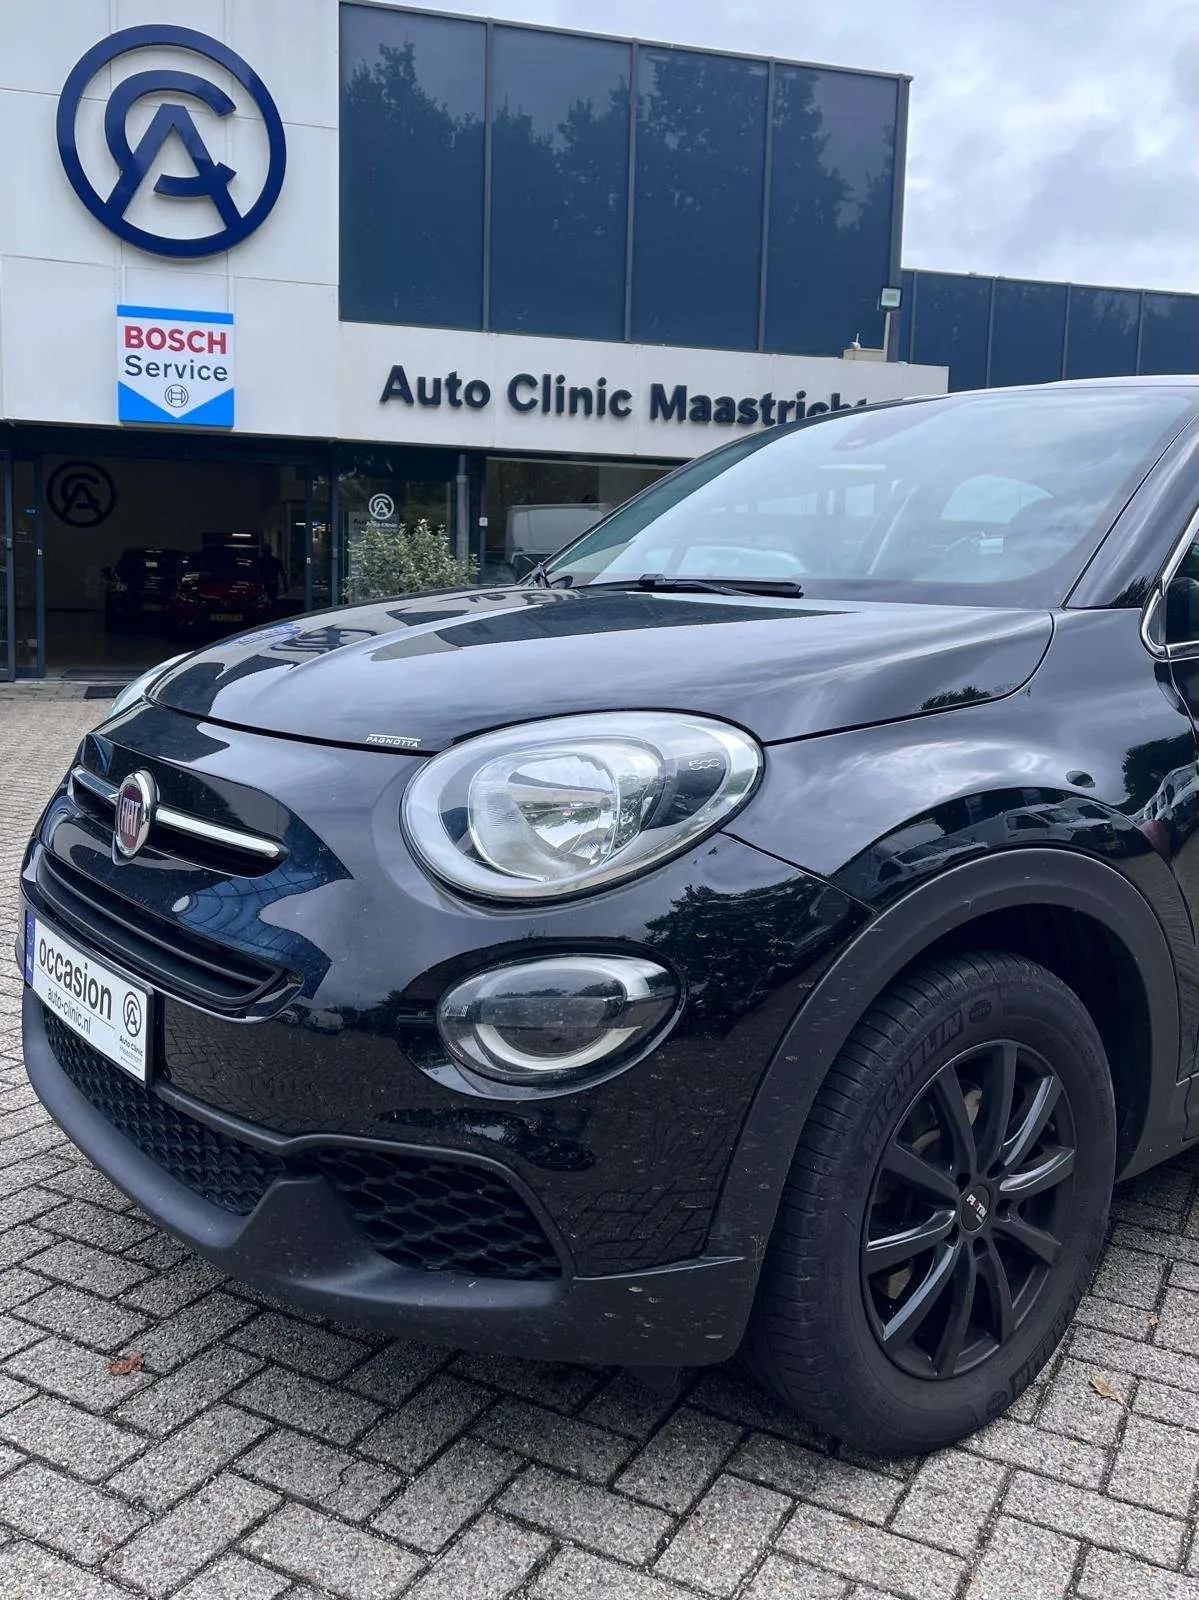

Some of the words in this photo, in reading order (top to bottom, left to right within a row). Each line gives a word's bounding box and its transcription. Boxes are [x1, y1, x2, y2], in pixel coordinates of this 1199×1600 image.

[124, 325, 228, 355] BOSCH
[124, 354, 228, 382] Service
[379, 364, 491, 409] Auto
[506, 373, 633, 418] Clinic
[649, 382, 867, 427] Maastri
[366, 736, 418, 748] PAGNOTTA
[689, 758, 720, 770] 500
[119, 796, 142, 838] FIAT
[39, 938, 112, 1020] occasion
[47, 986, 91, 1037] auto-clinic.nl
